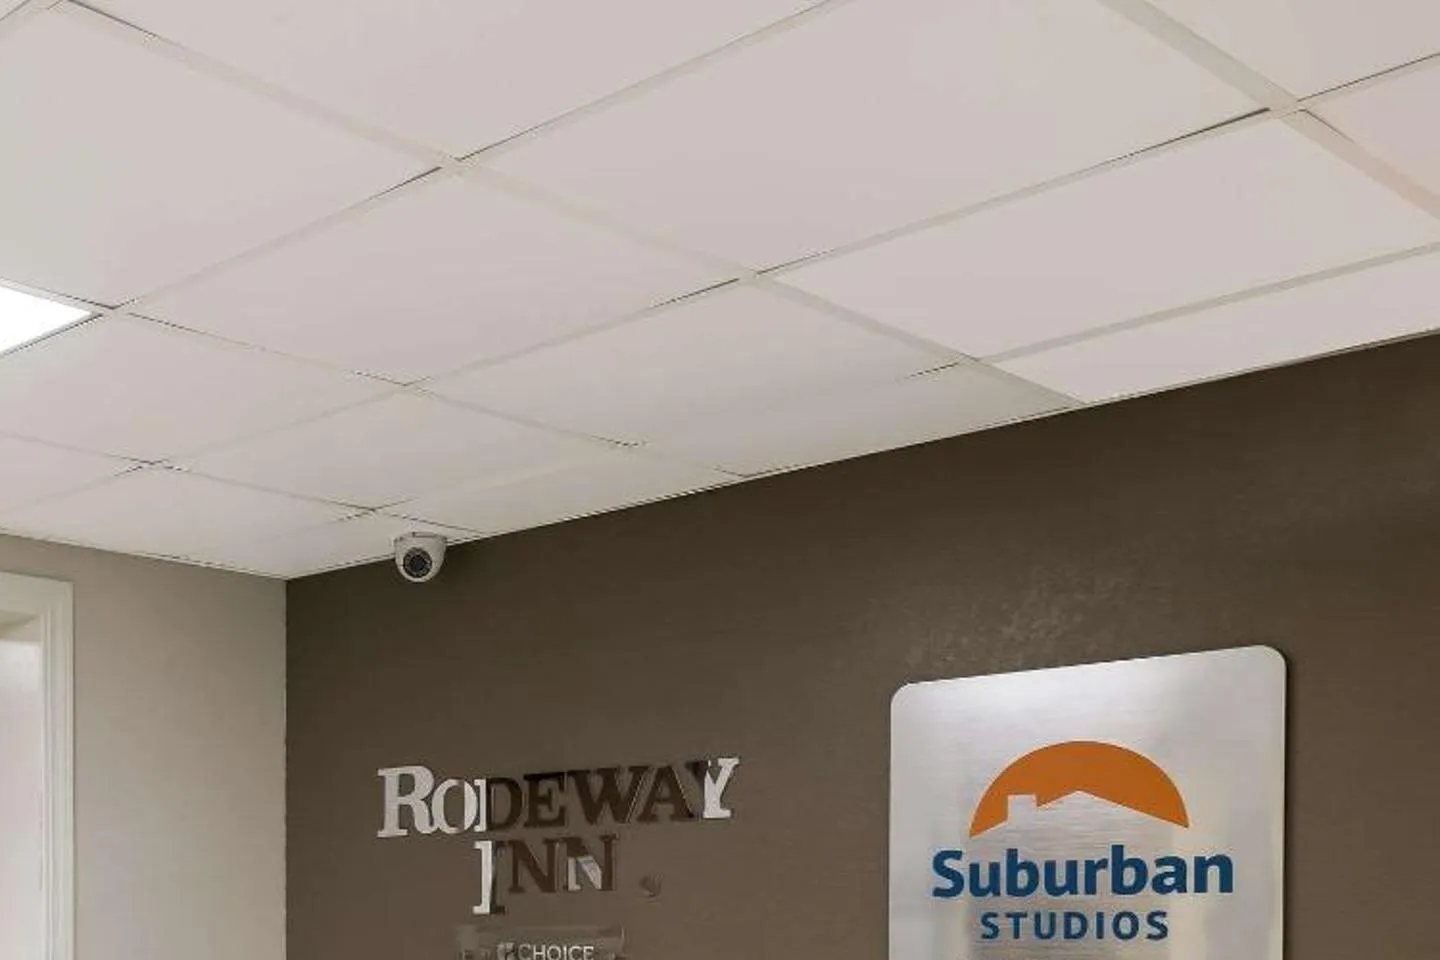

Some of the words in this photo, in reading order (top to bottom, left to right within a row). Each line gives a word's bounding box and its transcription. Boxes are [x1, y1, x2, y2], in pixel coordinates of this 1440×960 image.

[473, 834, 617, 915] INN
[932, 845, 1234, 898] Suburban
[980, 911, 1169, 940] STUDIOS
